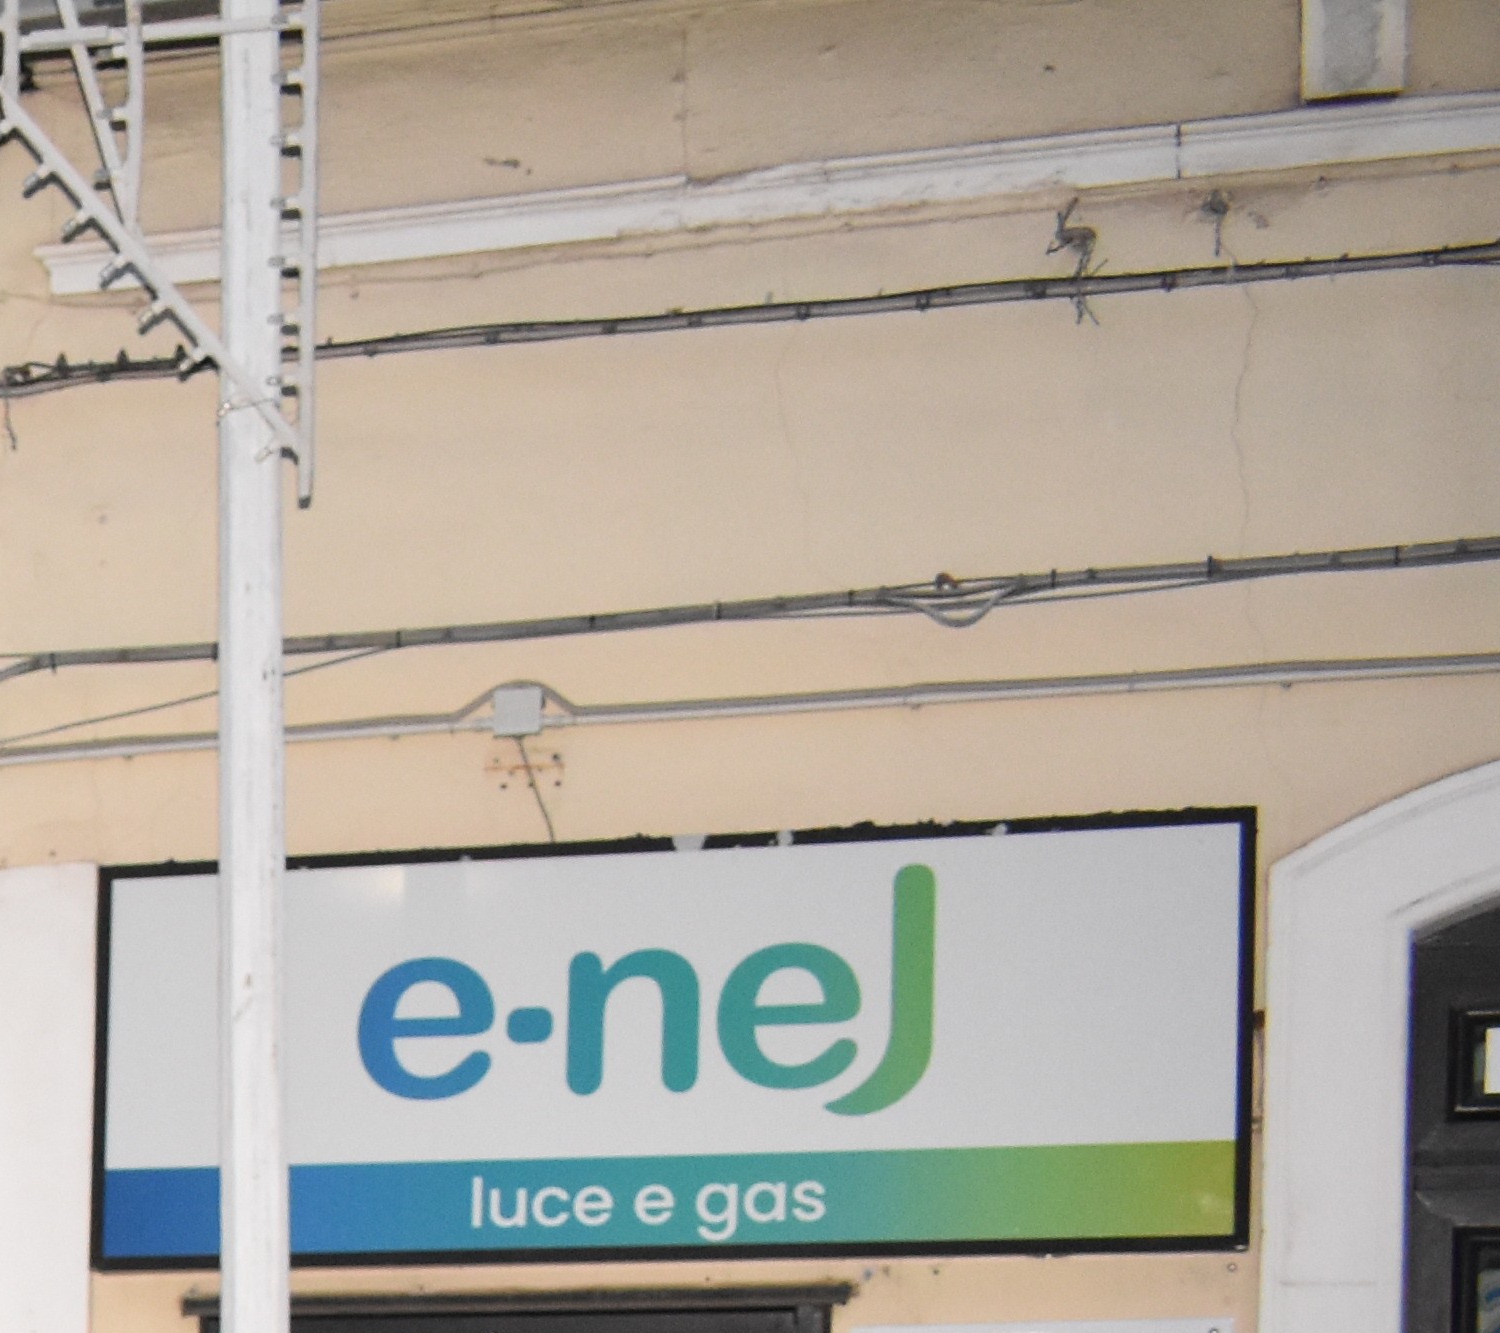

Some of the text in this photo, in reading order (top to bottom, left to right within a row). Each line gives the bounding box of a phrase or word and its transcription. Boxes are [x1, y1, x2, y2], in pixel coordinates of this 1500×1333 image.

[470, 1176, 826, 1240] luce e gas
